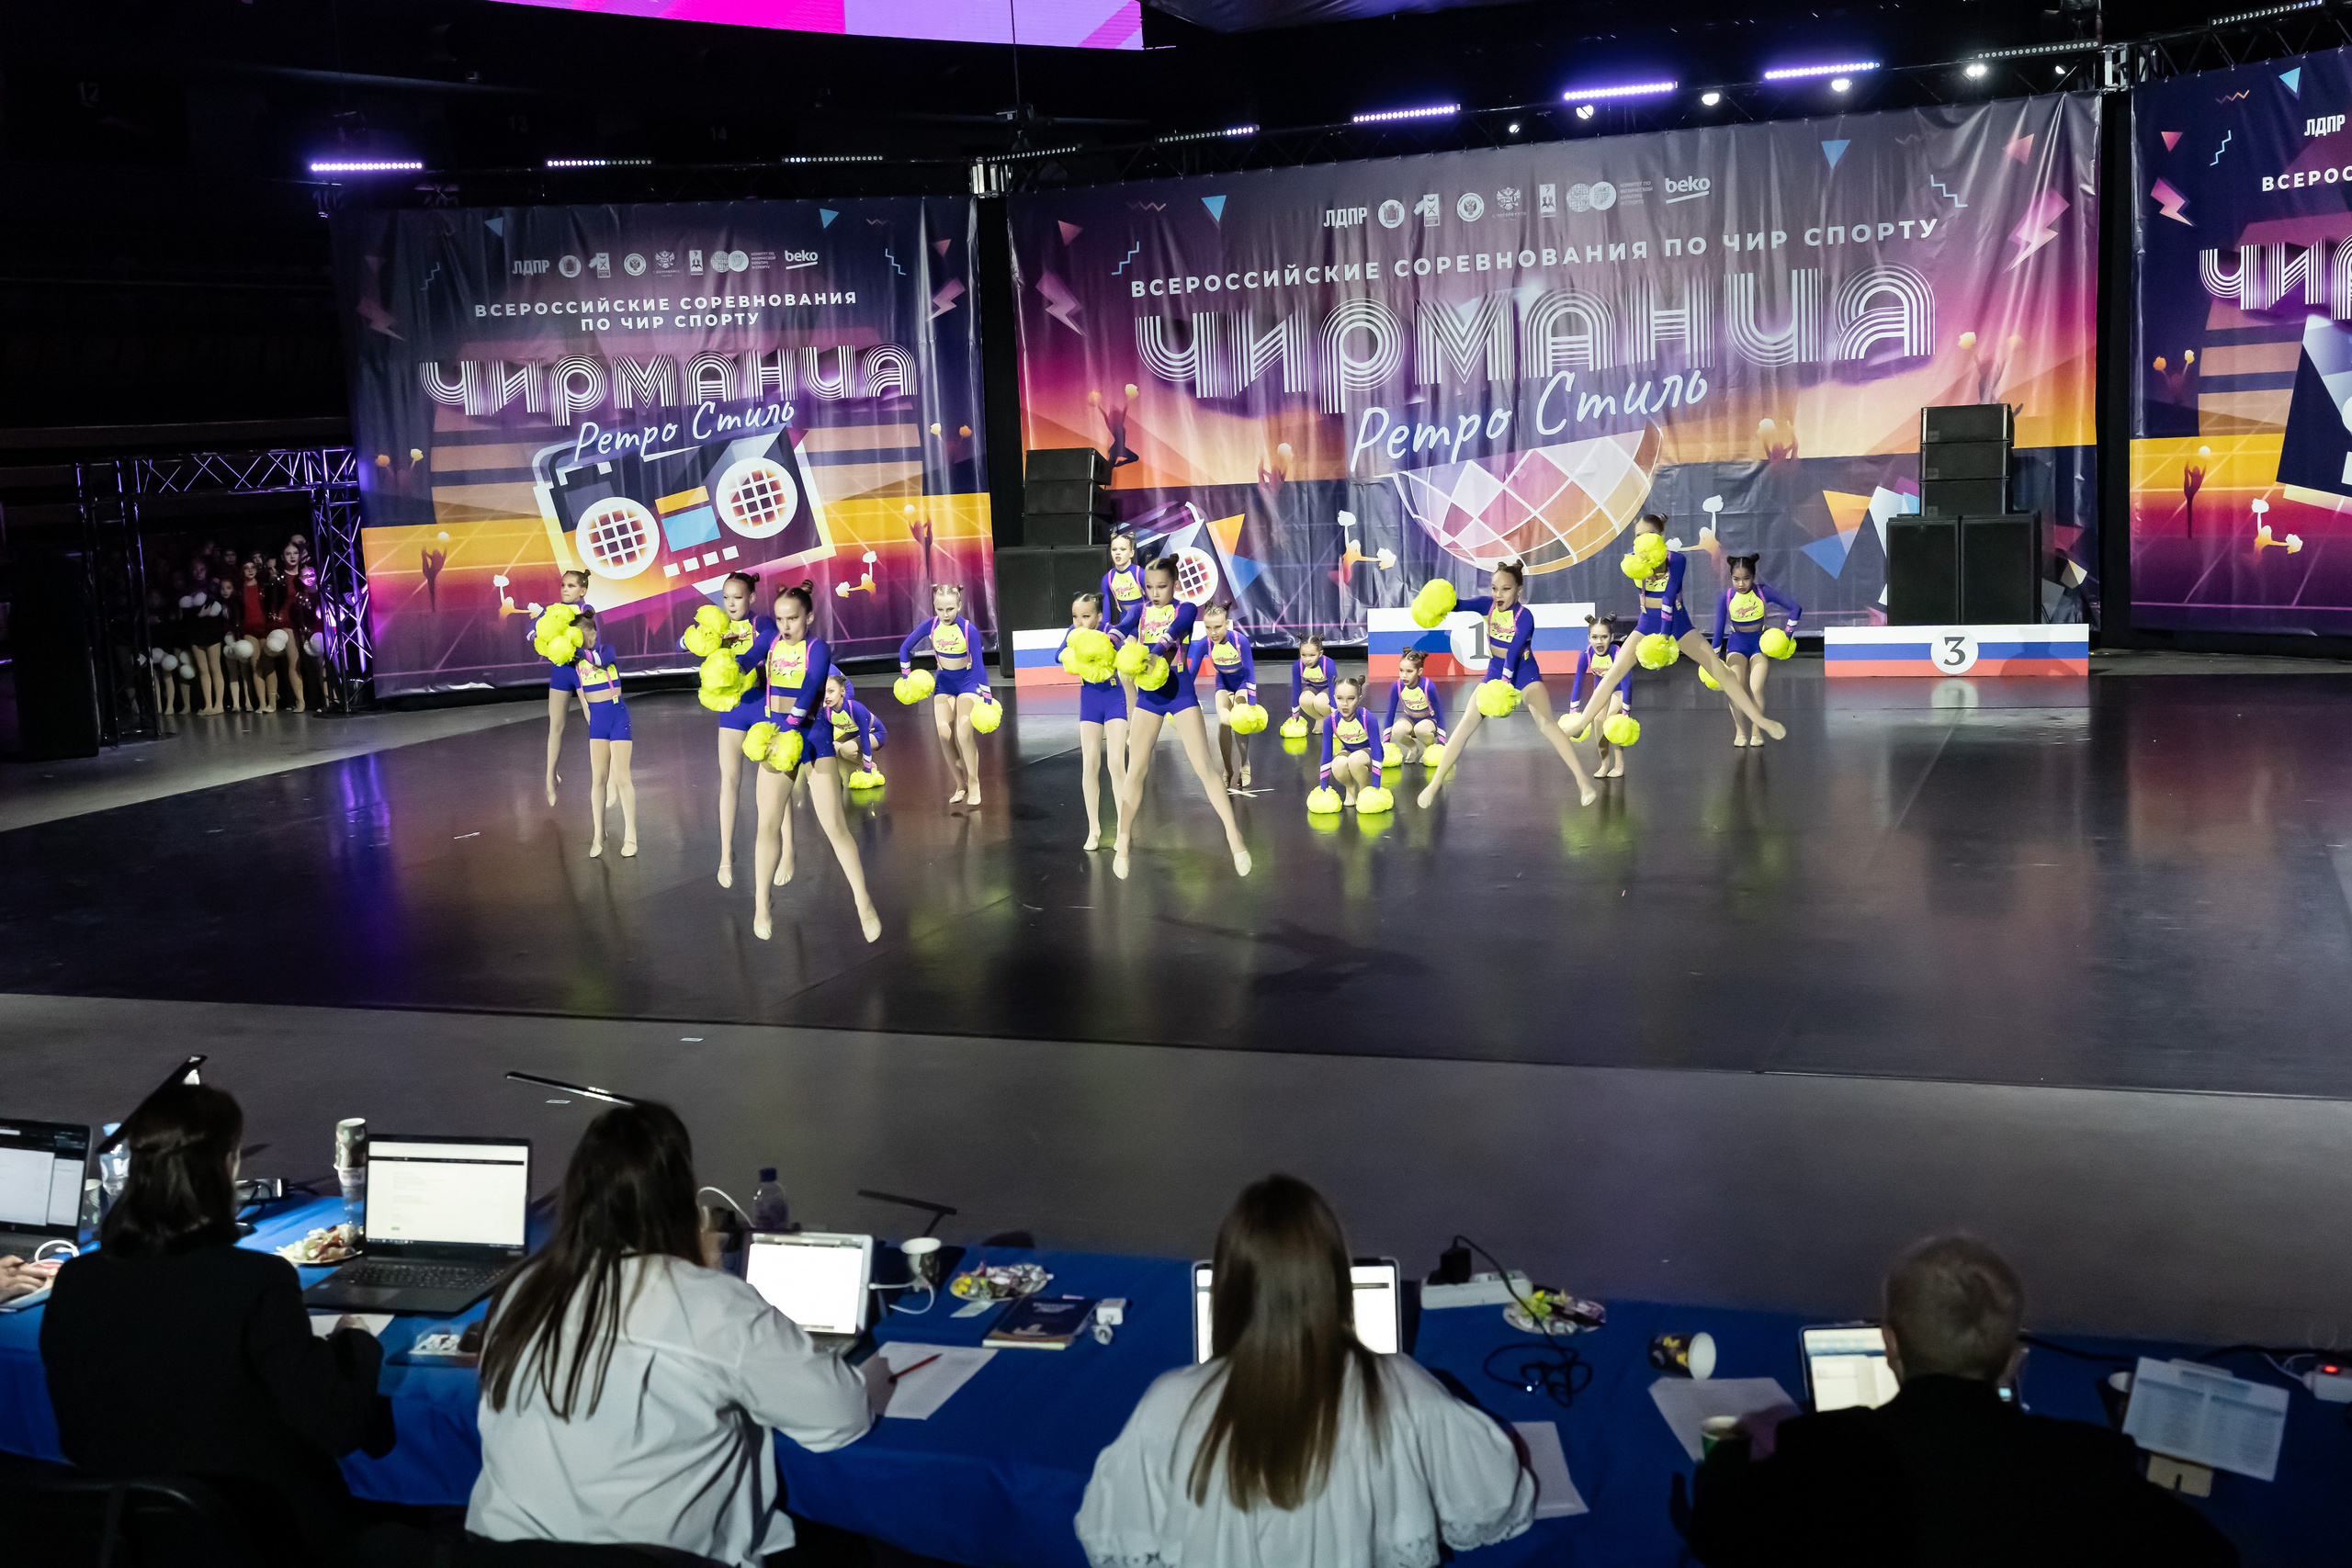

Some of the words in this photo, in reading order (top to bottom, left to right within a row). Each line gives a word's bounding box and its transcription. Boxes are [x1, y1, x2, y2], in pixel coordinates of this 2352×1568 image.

[2303, 114, 2346, 138] ЛДПР
[1665, 175, 1711, 194] beko
[1323, 207, 1368, 229] ЛДПР
[512, 259, 550, 276] ЛДПР
[785, 249, 819, 262] beko
[1131, 262, 1379, 298] ВСЕРОССИЙСКИЕ
[1394, 241, 1647, 276] СОРЕВНОВАНИЯ
[1665, 236, 1707, 257] ПО
[1723, 231, 1788, 252] ЧИР
[1804, 219, 1938, 246] СПОРТУ
[475, 298, 670, 317] ВСЕРОССИЙСКИЕ
[680, 291, 856, 310] СОРЕВНОВАНИЯ
[581, 318, 611, 332] ПО
[620, 316, 664, 330] ЧИР
[674, 312, 759, 328] СПОРТУ
[575, 422, 677, 462] Ретро
[692, 400, 796, 439] Стиль
[1351, 407, 1512, 472] Ретро
[1535, 369, 1709, 435] Стиль
[1468, 621, 1490, 660] 1
[1943, 637, 1966, 666] 3
